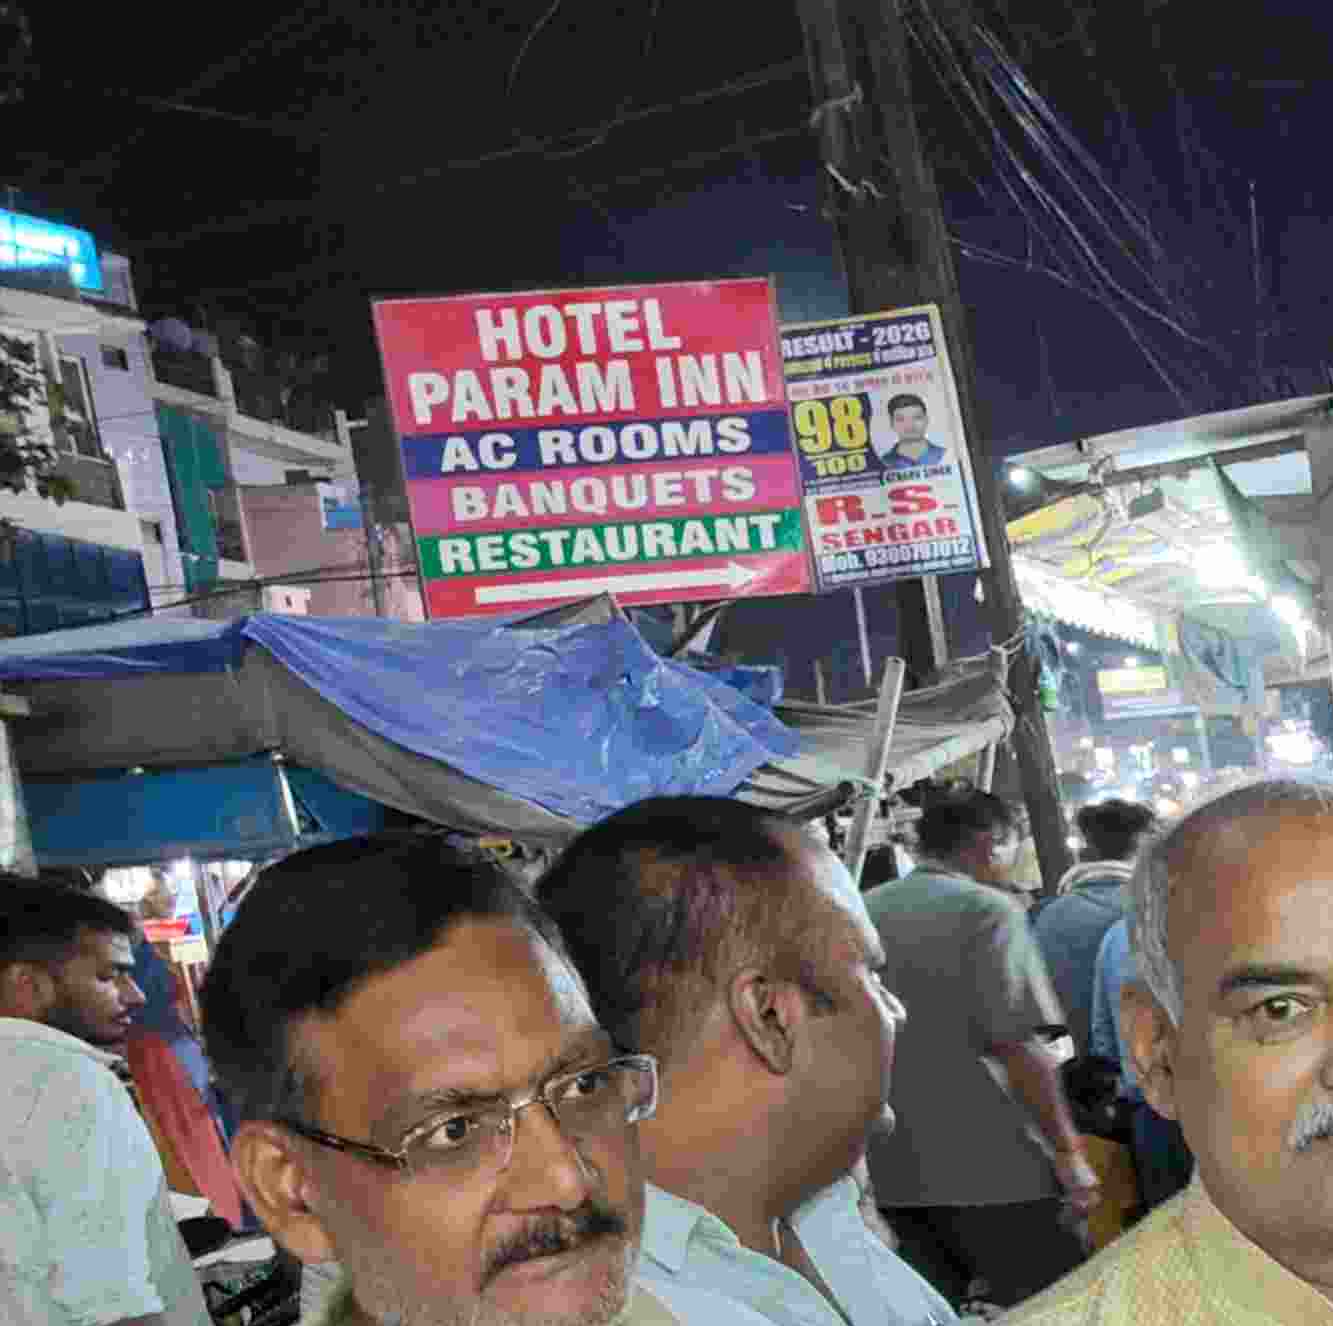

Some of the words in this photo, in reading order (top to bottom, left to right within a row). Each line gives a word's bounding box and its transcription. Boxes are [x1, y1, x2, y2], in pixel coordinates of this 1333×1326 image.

[475, 298, 681, 361] HOTEL
[407, 359, 633, 425] PARAM
[657, 349, 770, 409] INN
[440, 430, 518, 474] AC
[538, 416, 752, 466] ROOMS
[793, 395, 869, 455] 98
[450, 466, 758, 522] BANQUETS
[814, 453, 867, 477] 100
[437, 512, 783, 575] RESTAURANT
[820, 516, 960, 549] SENGAR
